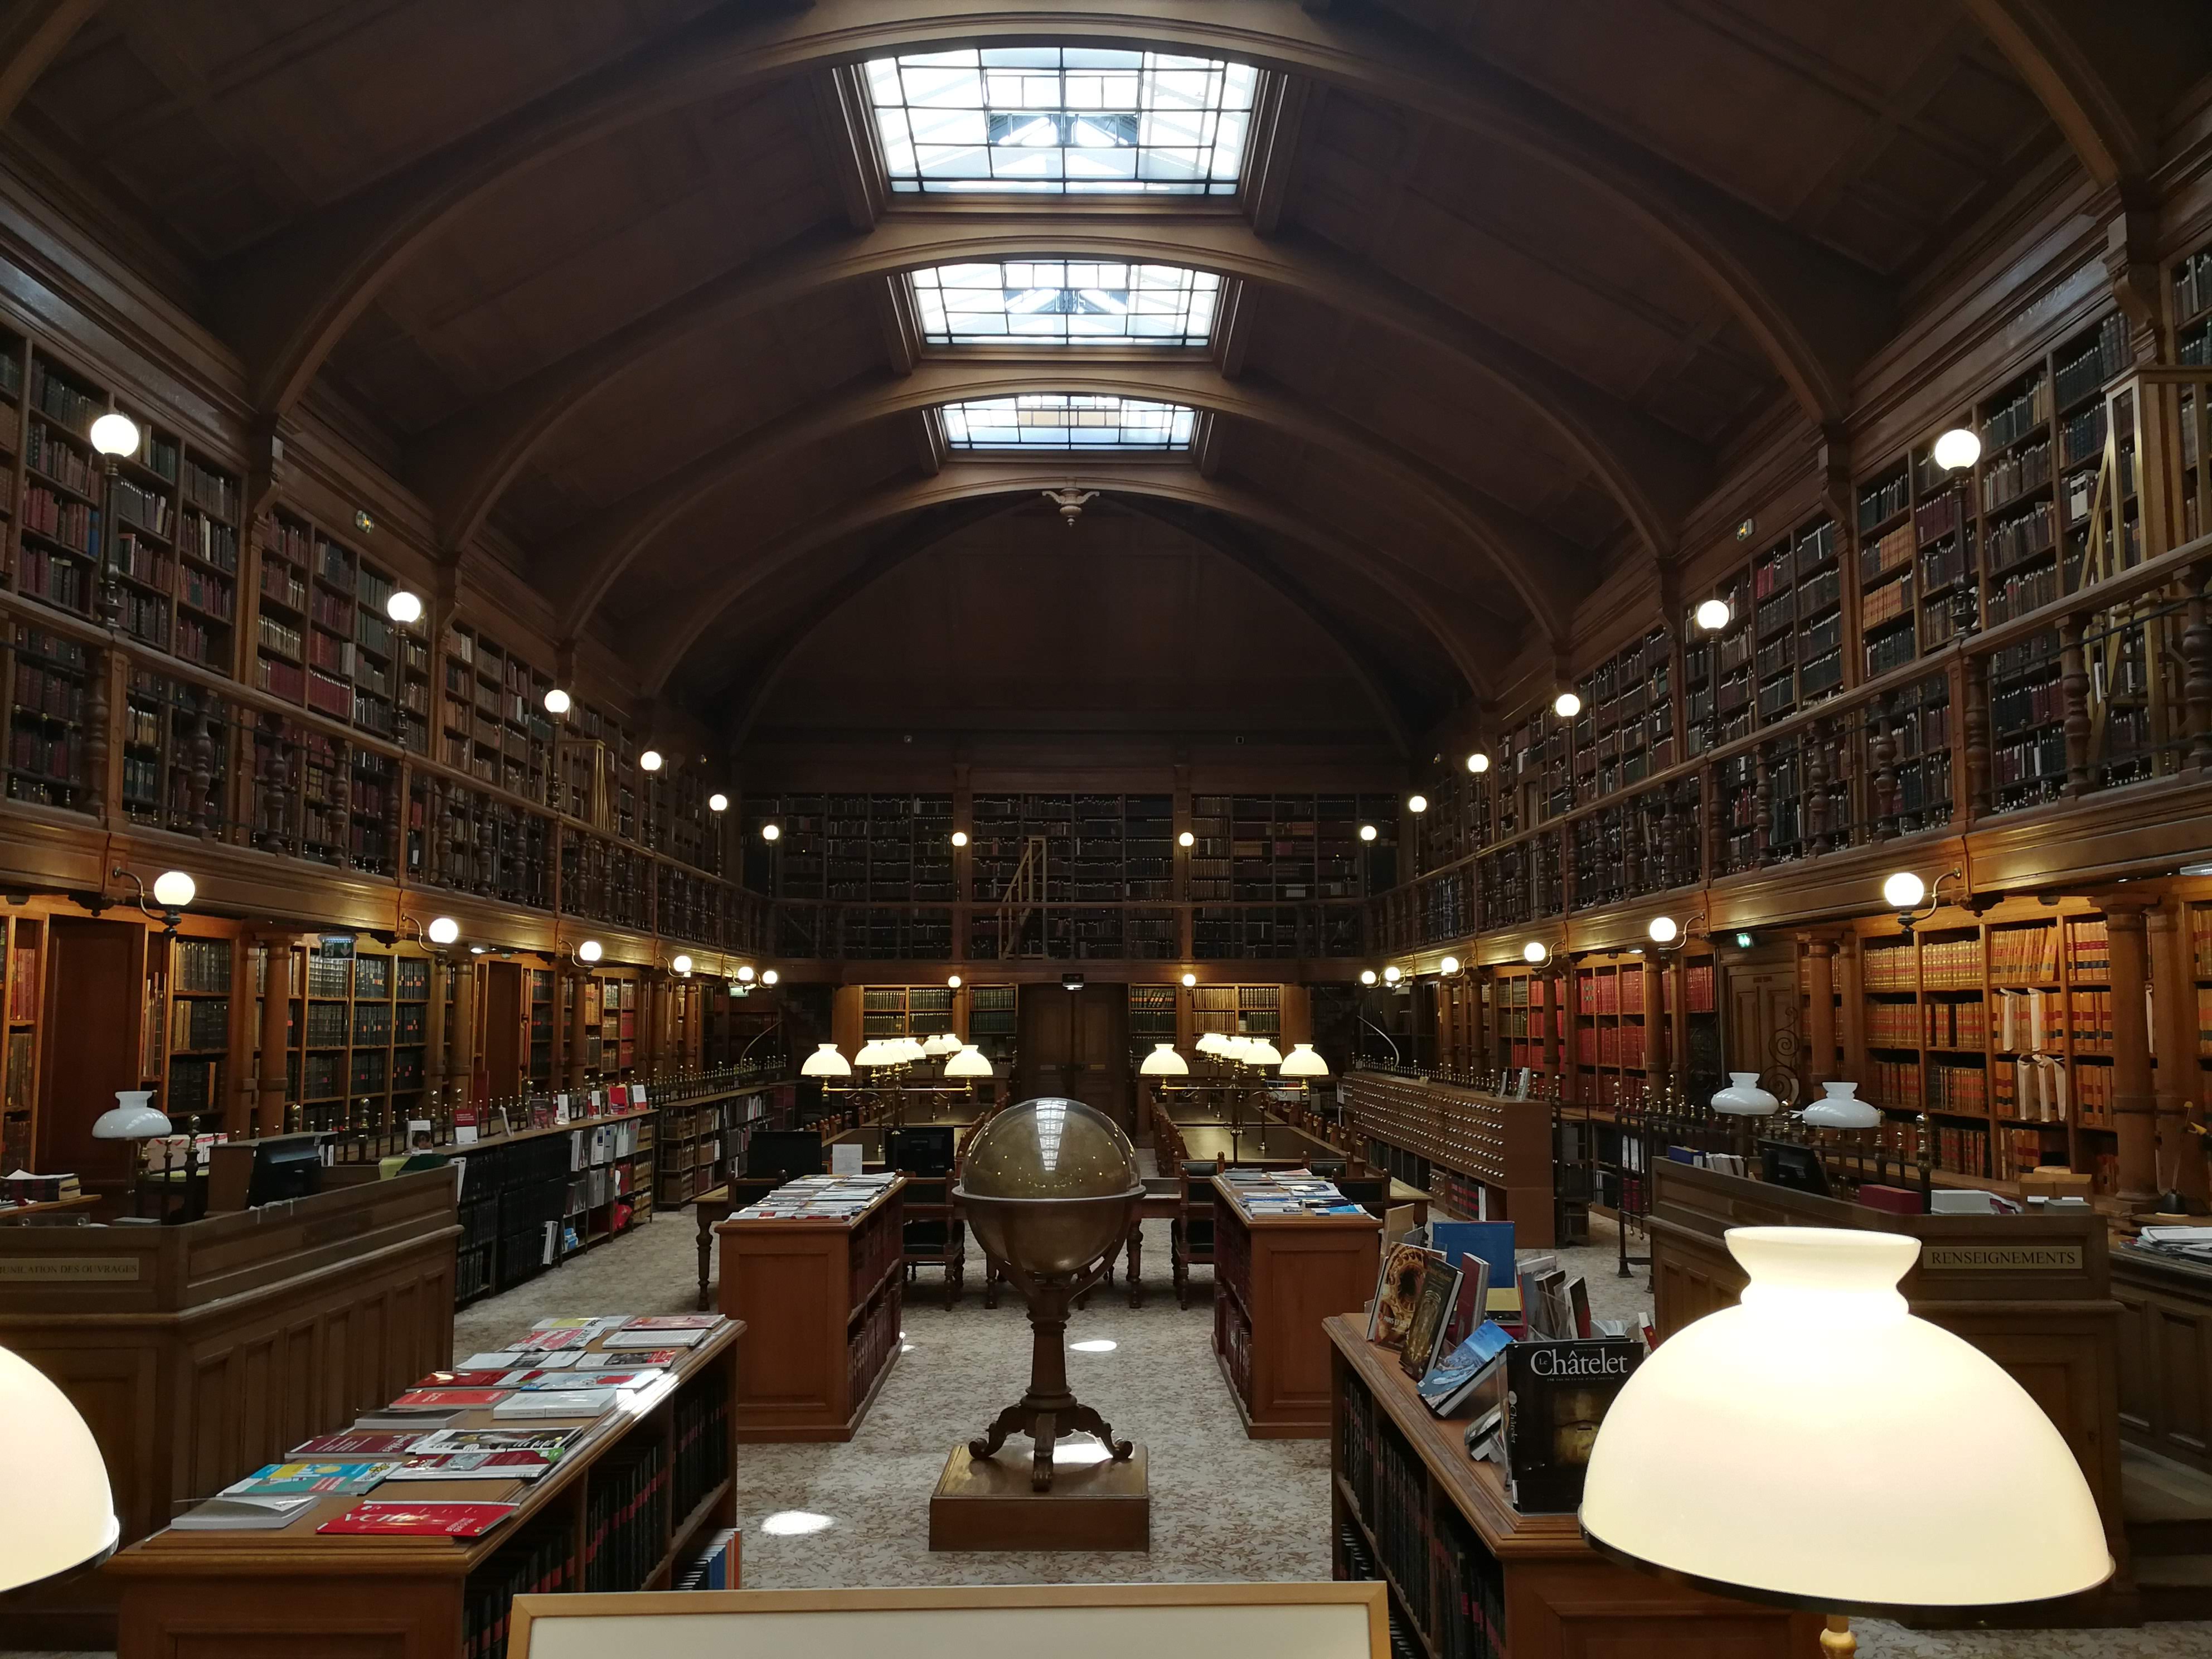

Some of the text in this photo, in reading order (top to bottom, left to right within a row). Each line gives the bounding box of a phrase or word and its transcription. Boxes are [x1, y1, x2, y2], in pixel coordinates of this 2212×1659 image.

[1932, 1251, 2075, 1264] RENSEIGNEMENTS
[82, 1265, 137, 1273] OUVRAGES
[1530, 1347, 1628, 1376] Châtelet
